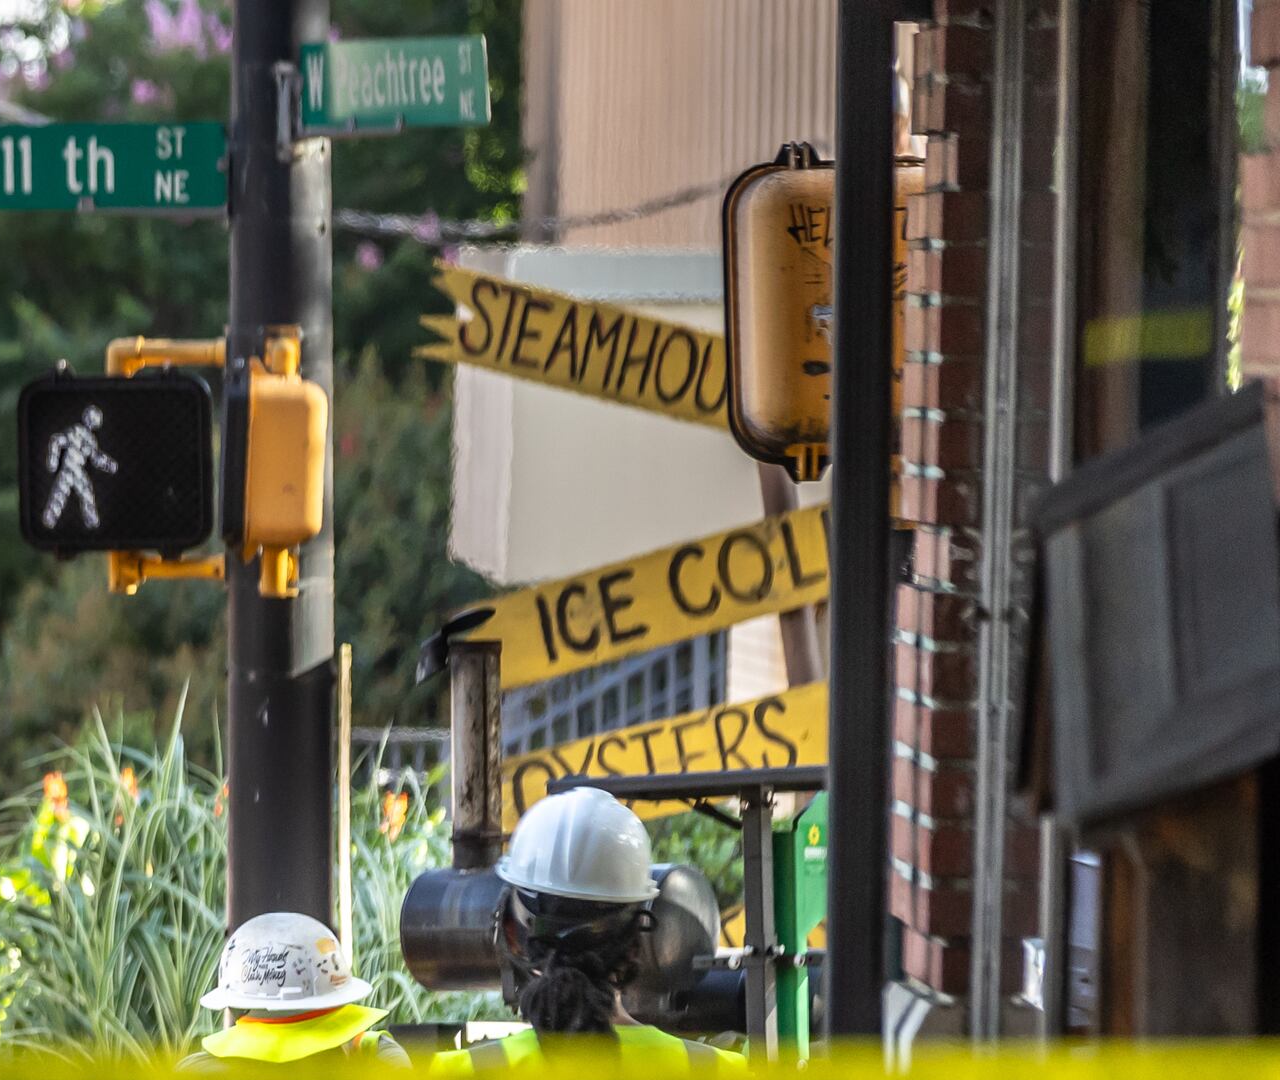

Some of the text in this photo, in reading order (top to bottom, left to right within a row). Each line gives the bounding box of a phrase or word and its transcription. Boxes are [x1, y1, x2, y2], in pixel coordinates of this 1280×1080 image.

[306, 50, 446, 112] W Peachtree
[458, 43, 472, 75] ST
[459, 88, 476, 121] NE
[1, 135, 116, 195] 11 th
[156, 126, 186, 160] ST
[154, 169, 190, 204] NE
[458, 277, 727, 412] STEAMHOU
[535, 510, 833, 663] ICE COL
